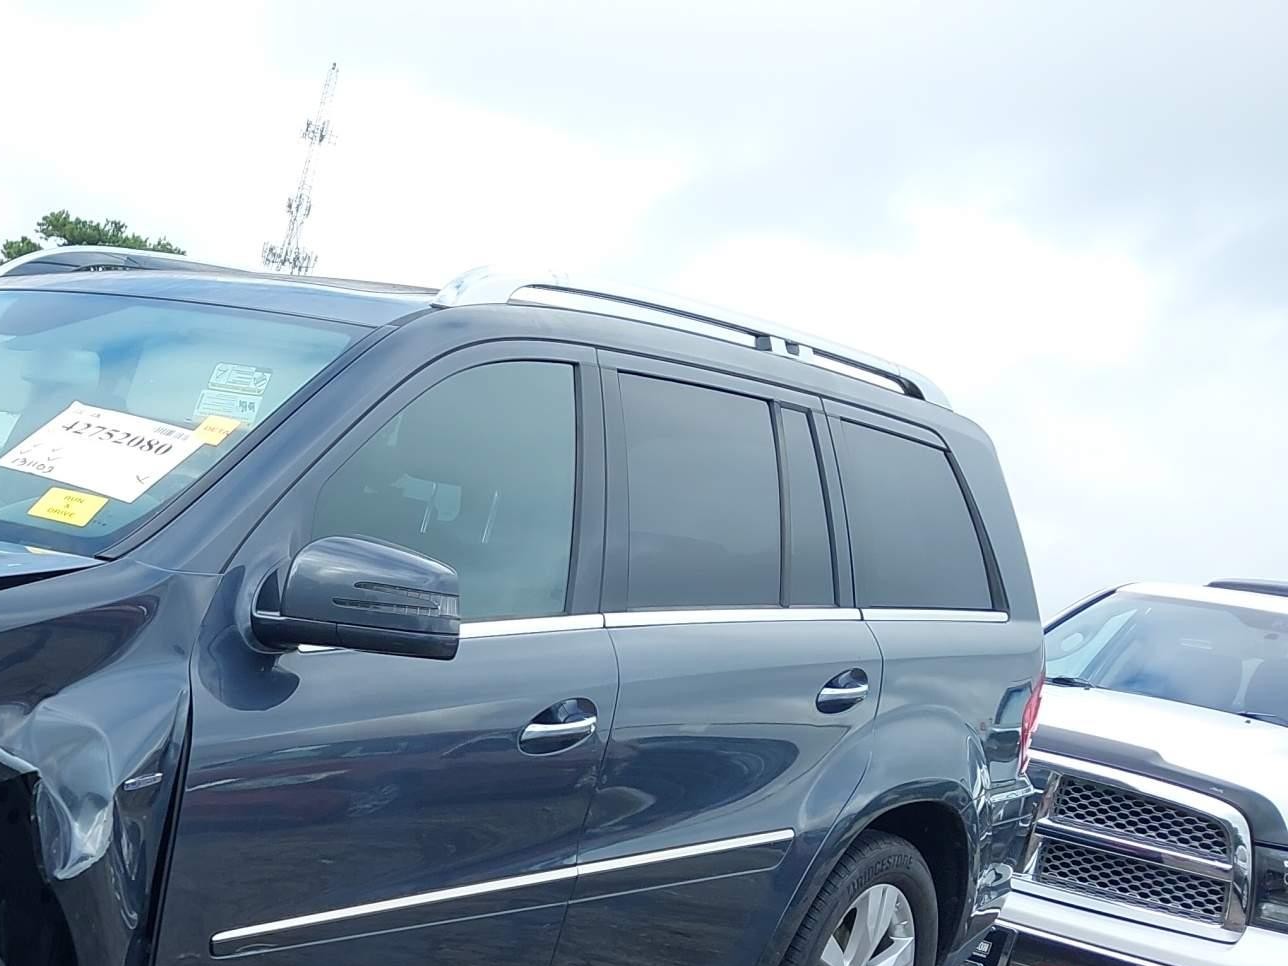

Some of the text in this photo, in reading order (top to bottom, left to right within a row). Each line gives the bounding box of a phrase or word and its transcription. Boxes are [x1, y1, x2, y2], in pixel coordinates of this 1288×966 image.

[61, 420, 174, 456] 42752080
[46, 507, 76, 518] DRIVE
[846, 854, 913, 898] BRIDGESTONE
